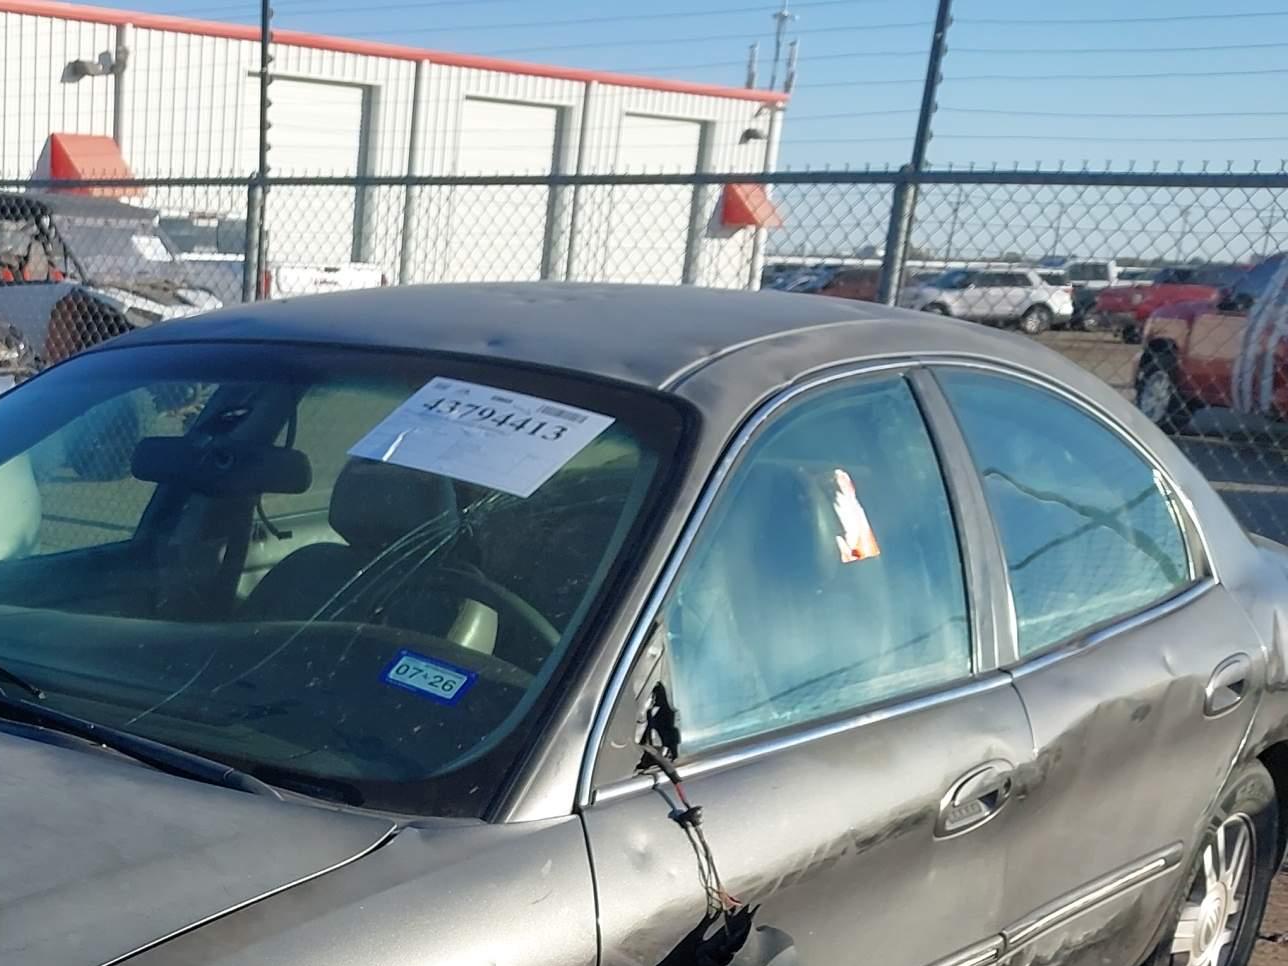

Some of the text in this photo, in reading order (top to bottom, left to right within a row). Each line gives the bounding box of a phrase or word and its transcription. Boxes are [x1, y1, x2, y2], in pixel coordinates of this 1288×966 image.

[423, 397, 568, 441] 43794413
[395, 663, 457, 693] 07 26
